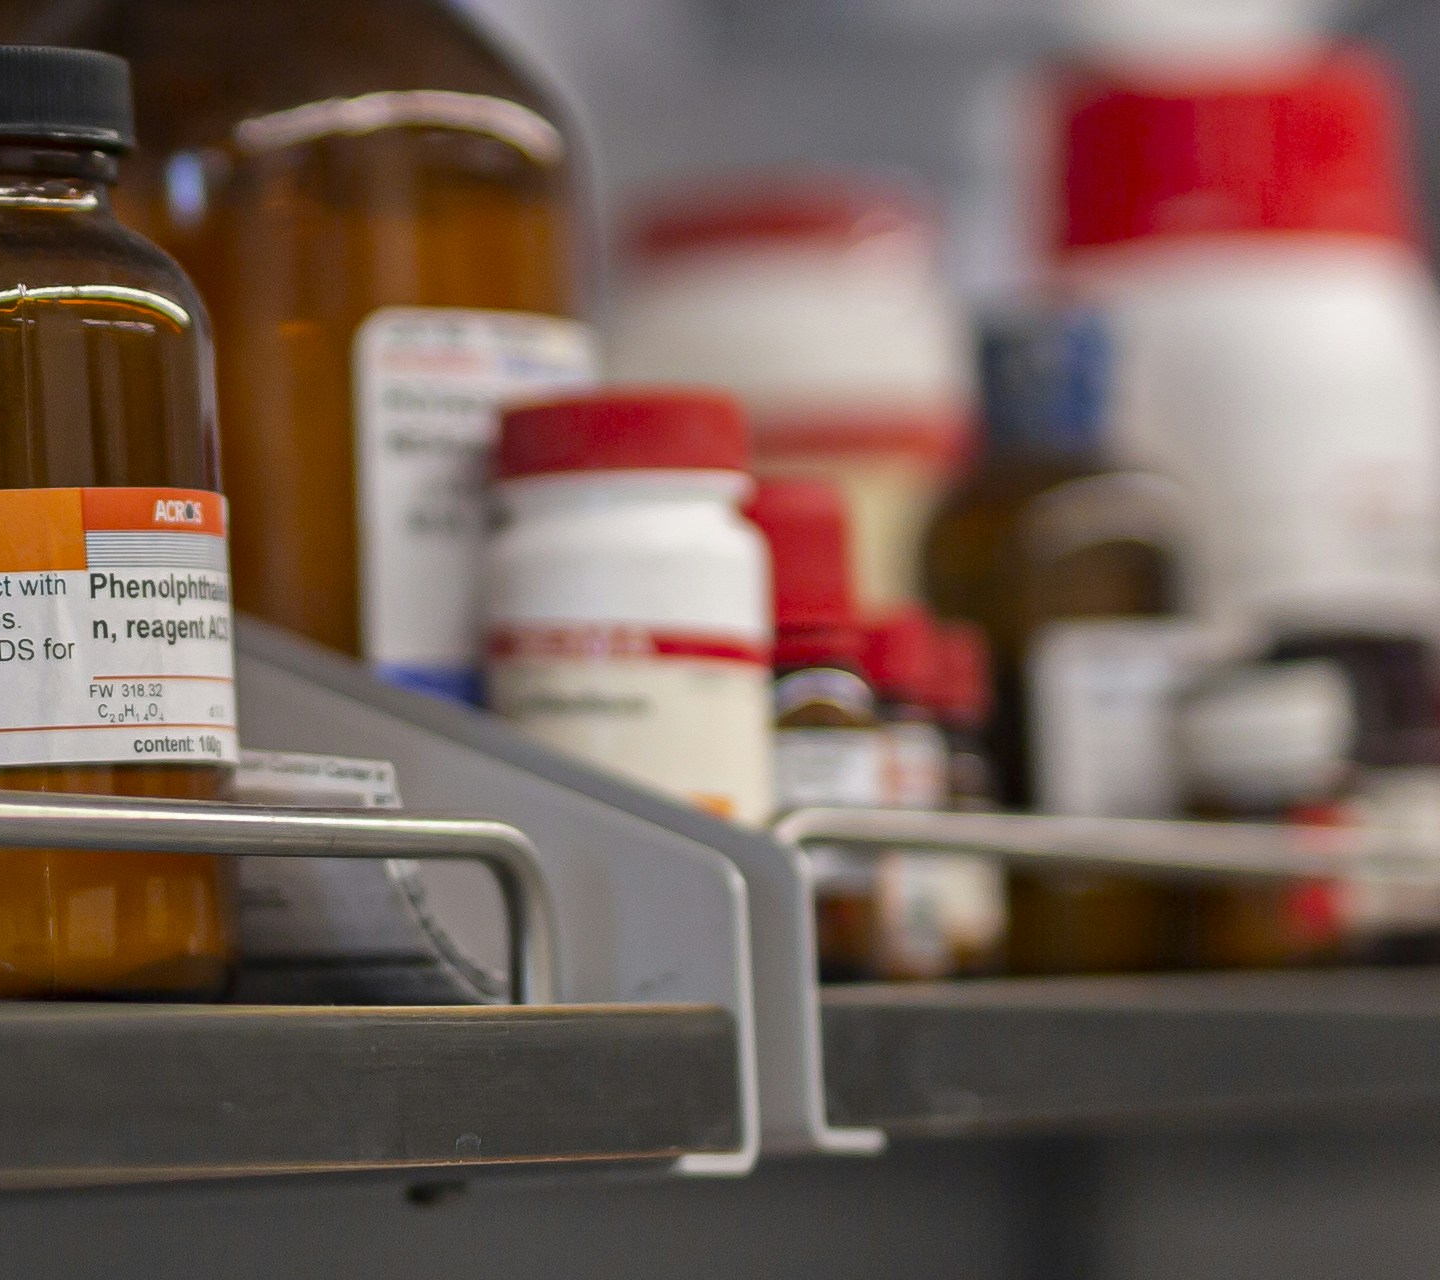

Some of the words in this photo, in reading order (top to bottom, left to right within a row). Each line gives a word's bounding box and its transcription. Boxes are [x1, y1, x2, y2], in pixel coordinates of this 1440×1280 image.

[19, 573, 67, 596] with
[92, 619, 118, 643] n,
[126, 616, 205, 646] reagent
[43, 637, 75, 660] for
[89, 683, 114, 698] FW
[121, 683, 163, 698] 318.32
[133, 735, 195, 754] content:
